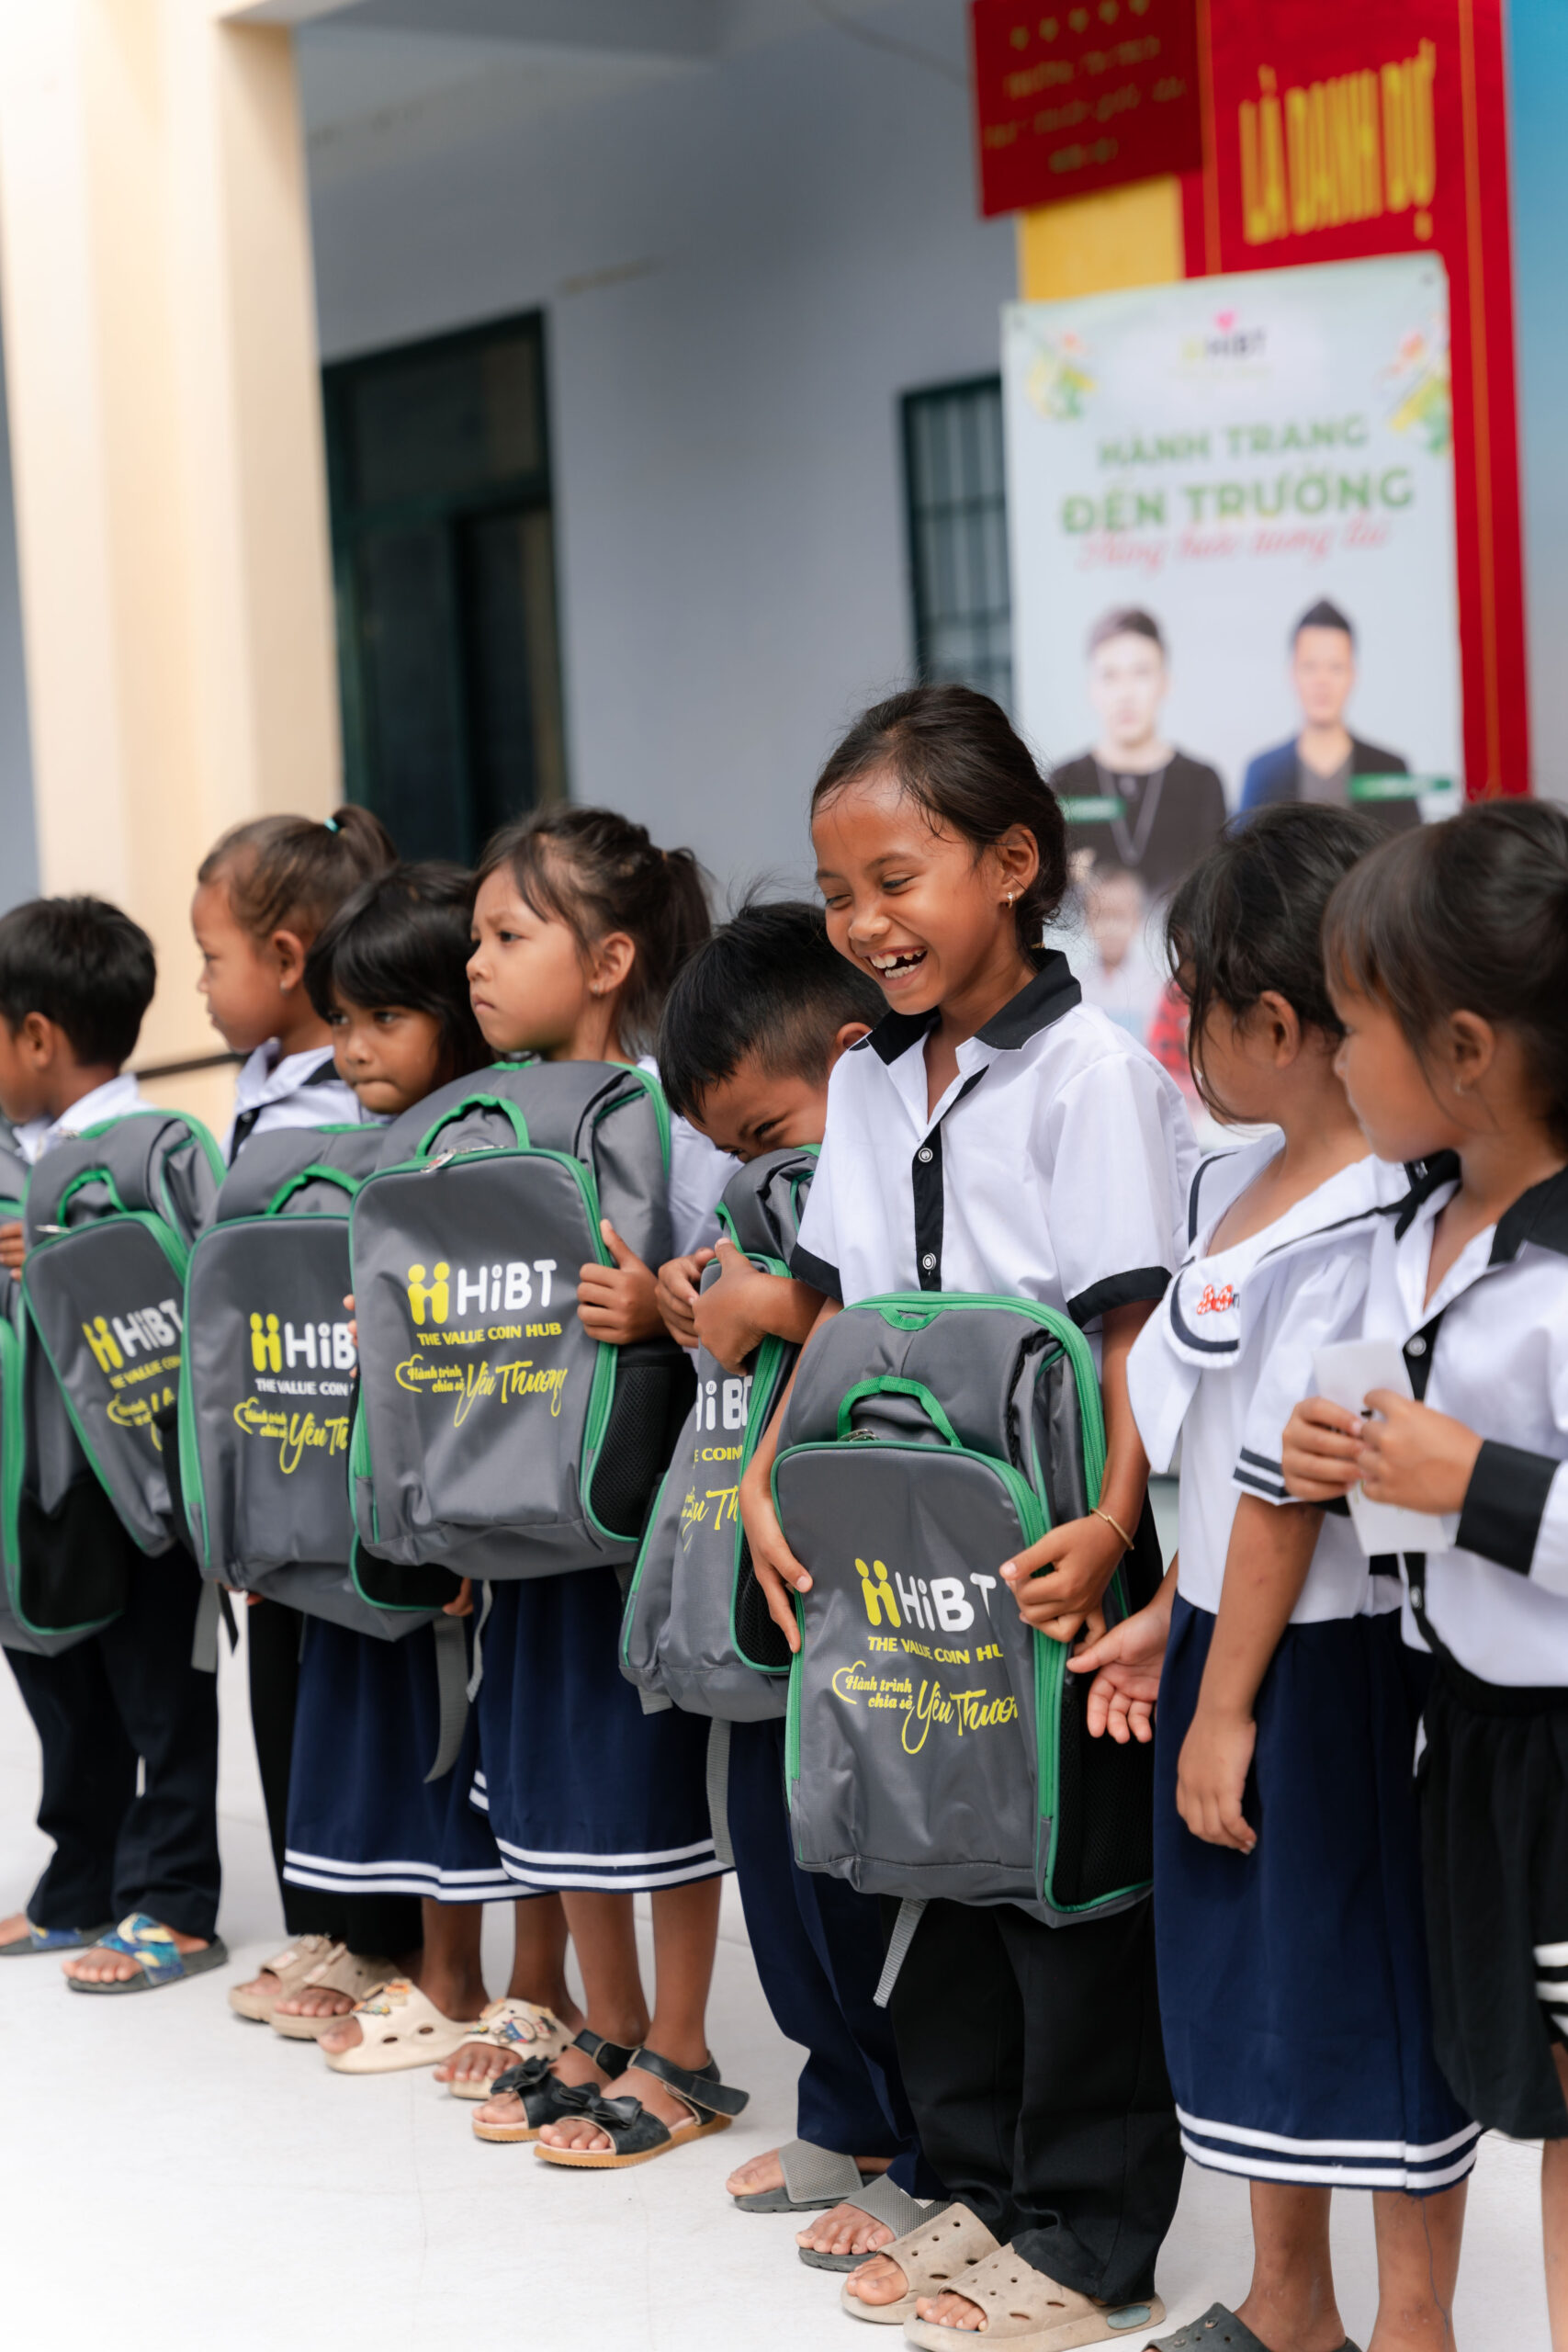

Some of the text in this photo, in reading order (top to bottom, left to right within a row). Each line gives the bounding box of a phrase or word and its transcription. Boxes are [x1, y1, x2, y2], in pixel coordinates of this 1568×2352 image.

[1224, 413, 1369, 459] TRANG
[457, 1259, 558, 1316] HiBT
[111, 1298, 184, 1357] HiBT
[284, 1322, 356, 1369] HiB
[416, 1322, 562, 1346] THE VALUE COIN HUB
[255, 1378, 276, 1393] THE
[276, 1380, 317, 1395] VALUE
[895, 1571, 997, 1632] HiBT
[868, 1636, 898, 1652] THE
[901, 1638, 933, 1659] VALUE
[934, 1647, 970, 1664] COIN
[868, 1692, 897, 1709] chia
